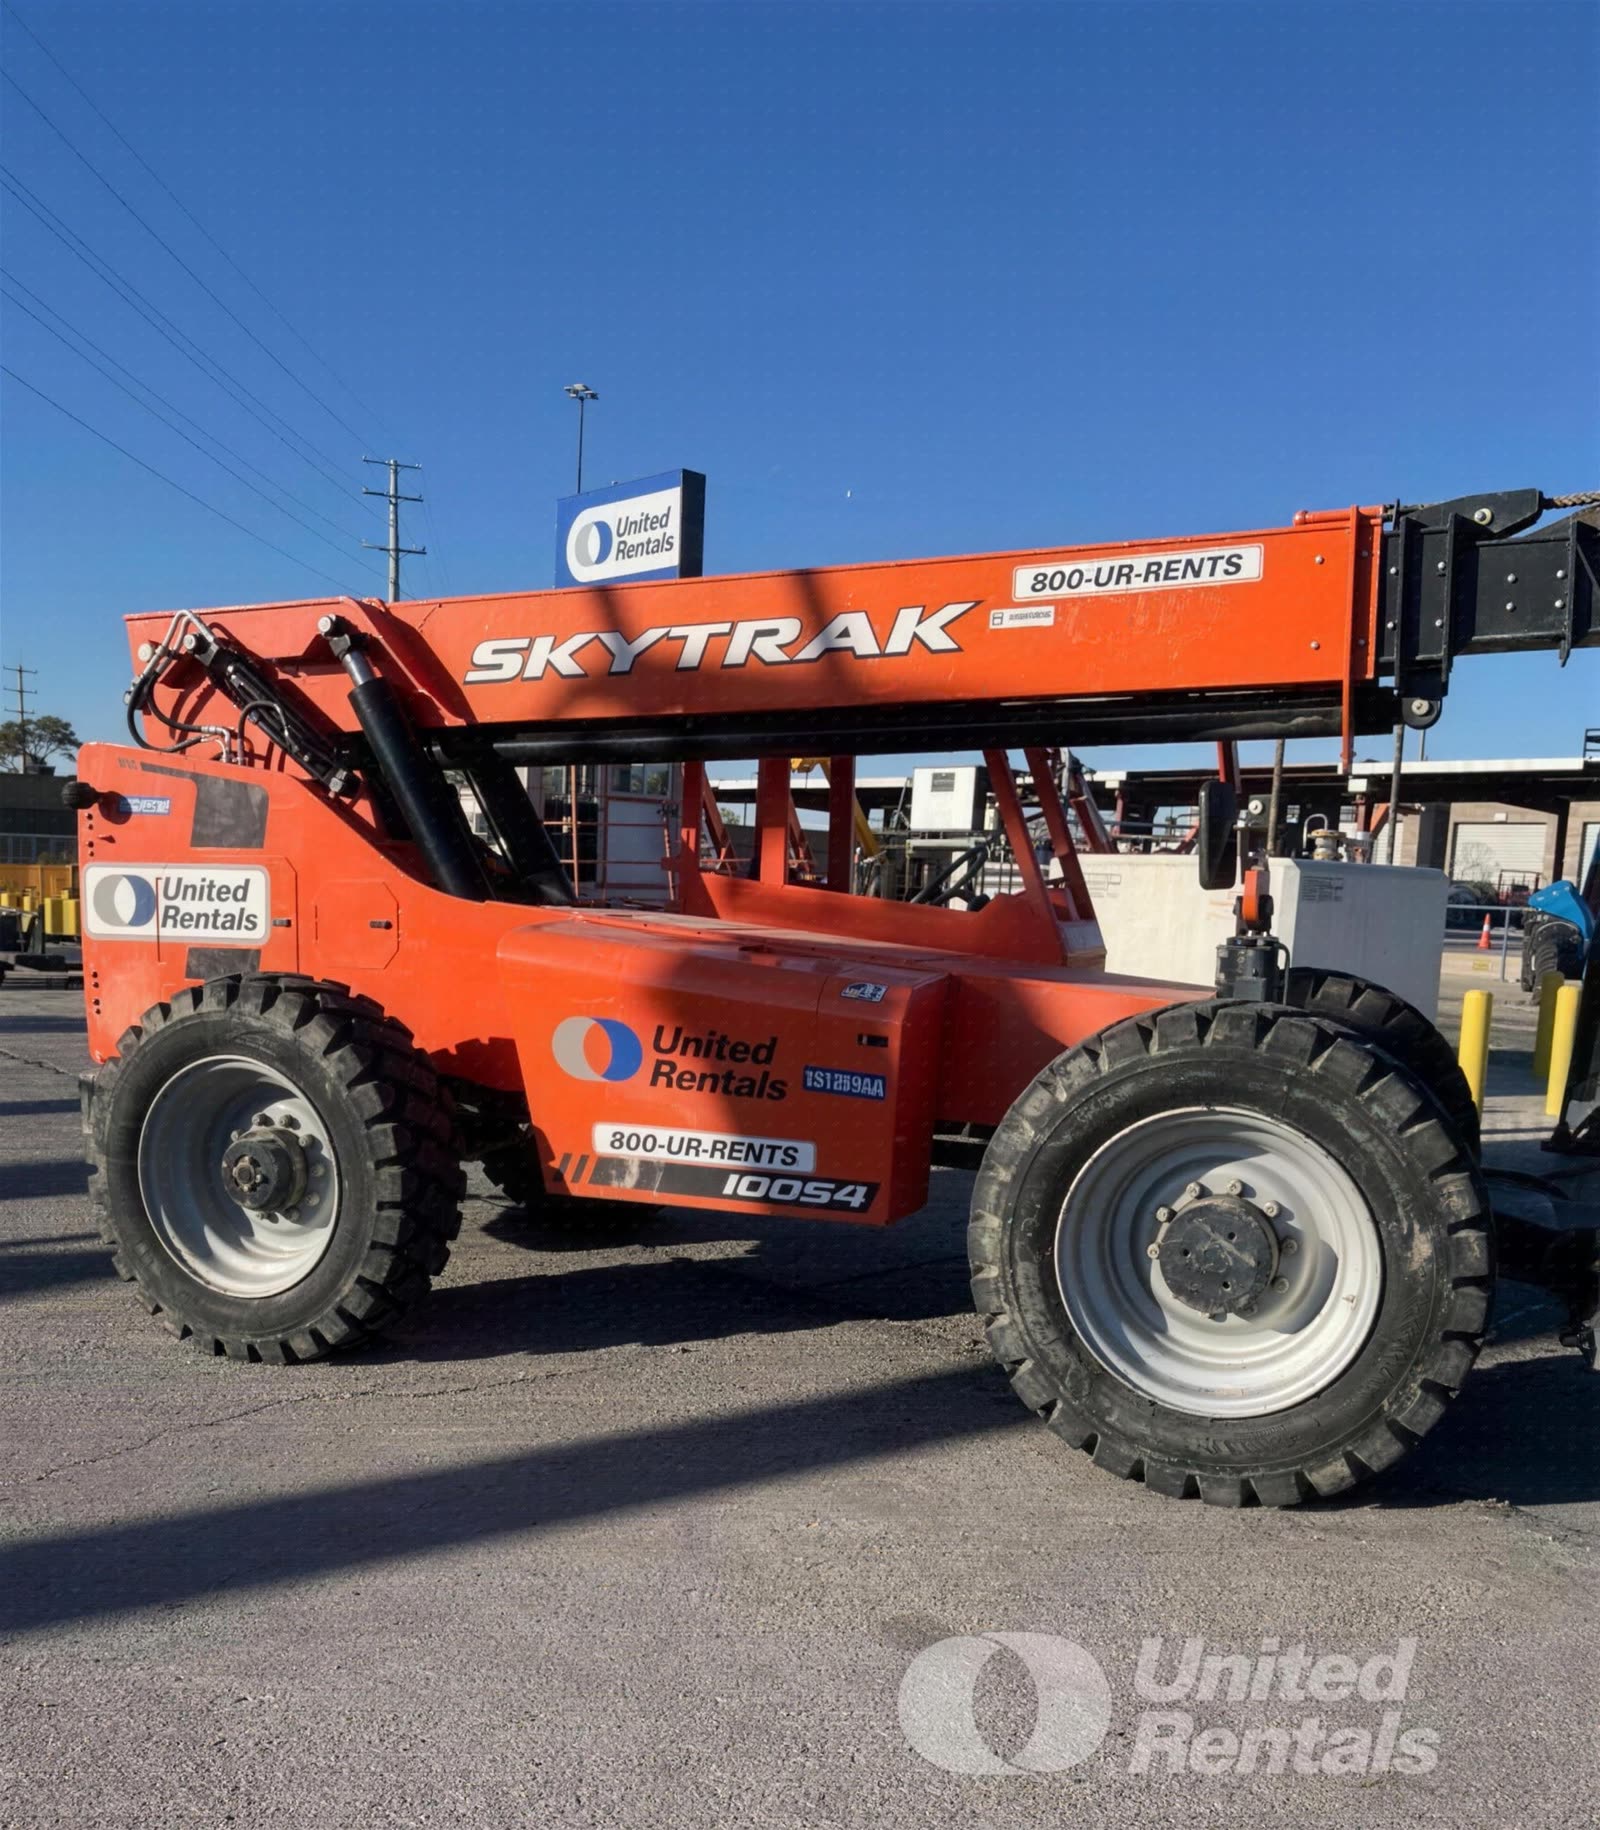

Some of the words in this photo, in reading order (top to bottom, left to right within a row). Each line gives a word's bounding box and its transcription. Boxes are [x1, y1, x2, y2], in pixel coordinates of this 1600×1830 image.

[616, 506, 672, 538] United
[615, 532, 674, 561] Rentals
[1030, 553, 1243, 593] 800-UR-RENTS
[463, 600, 984, 686] SKYTRAK
[162, 876, 251, 903] United
[161, 905, 258, 931] Rentals
[652, 1025, 778, 1066] United
[649, 1059, 789, 1101] Rentals
[609, 1131, 800, 1167] 800-UR-RENTS
